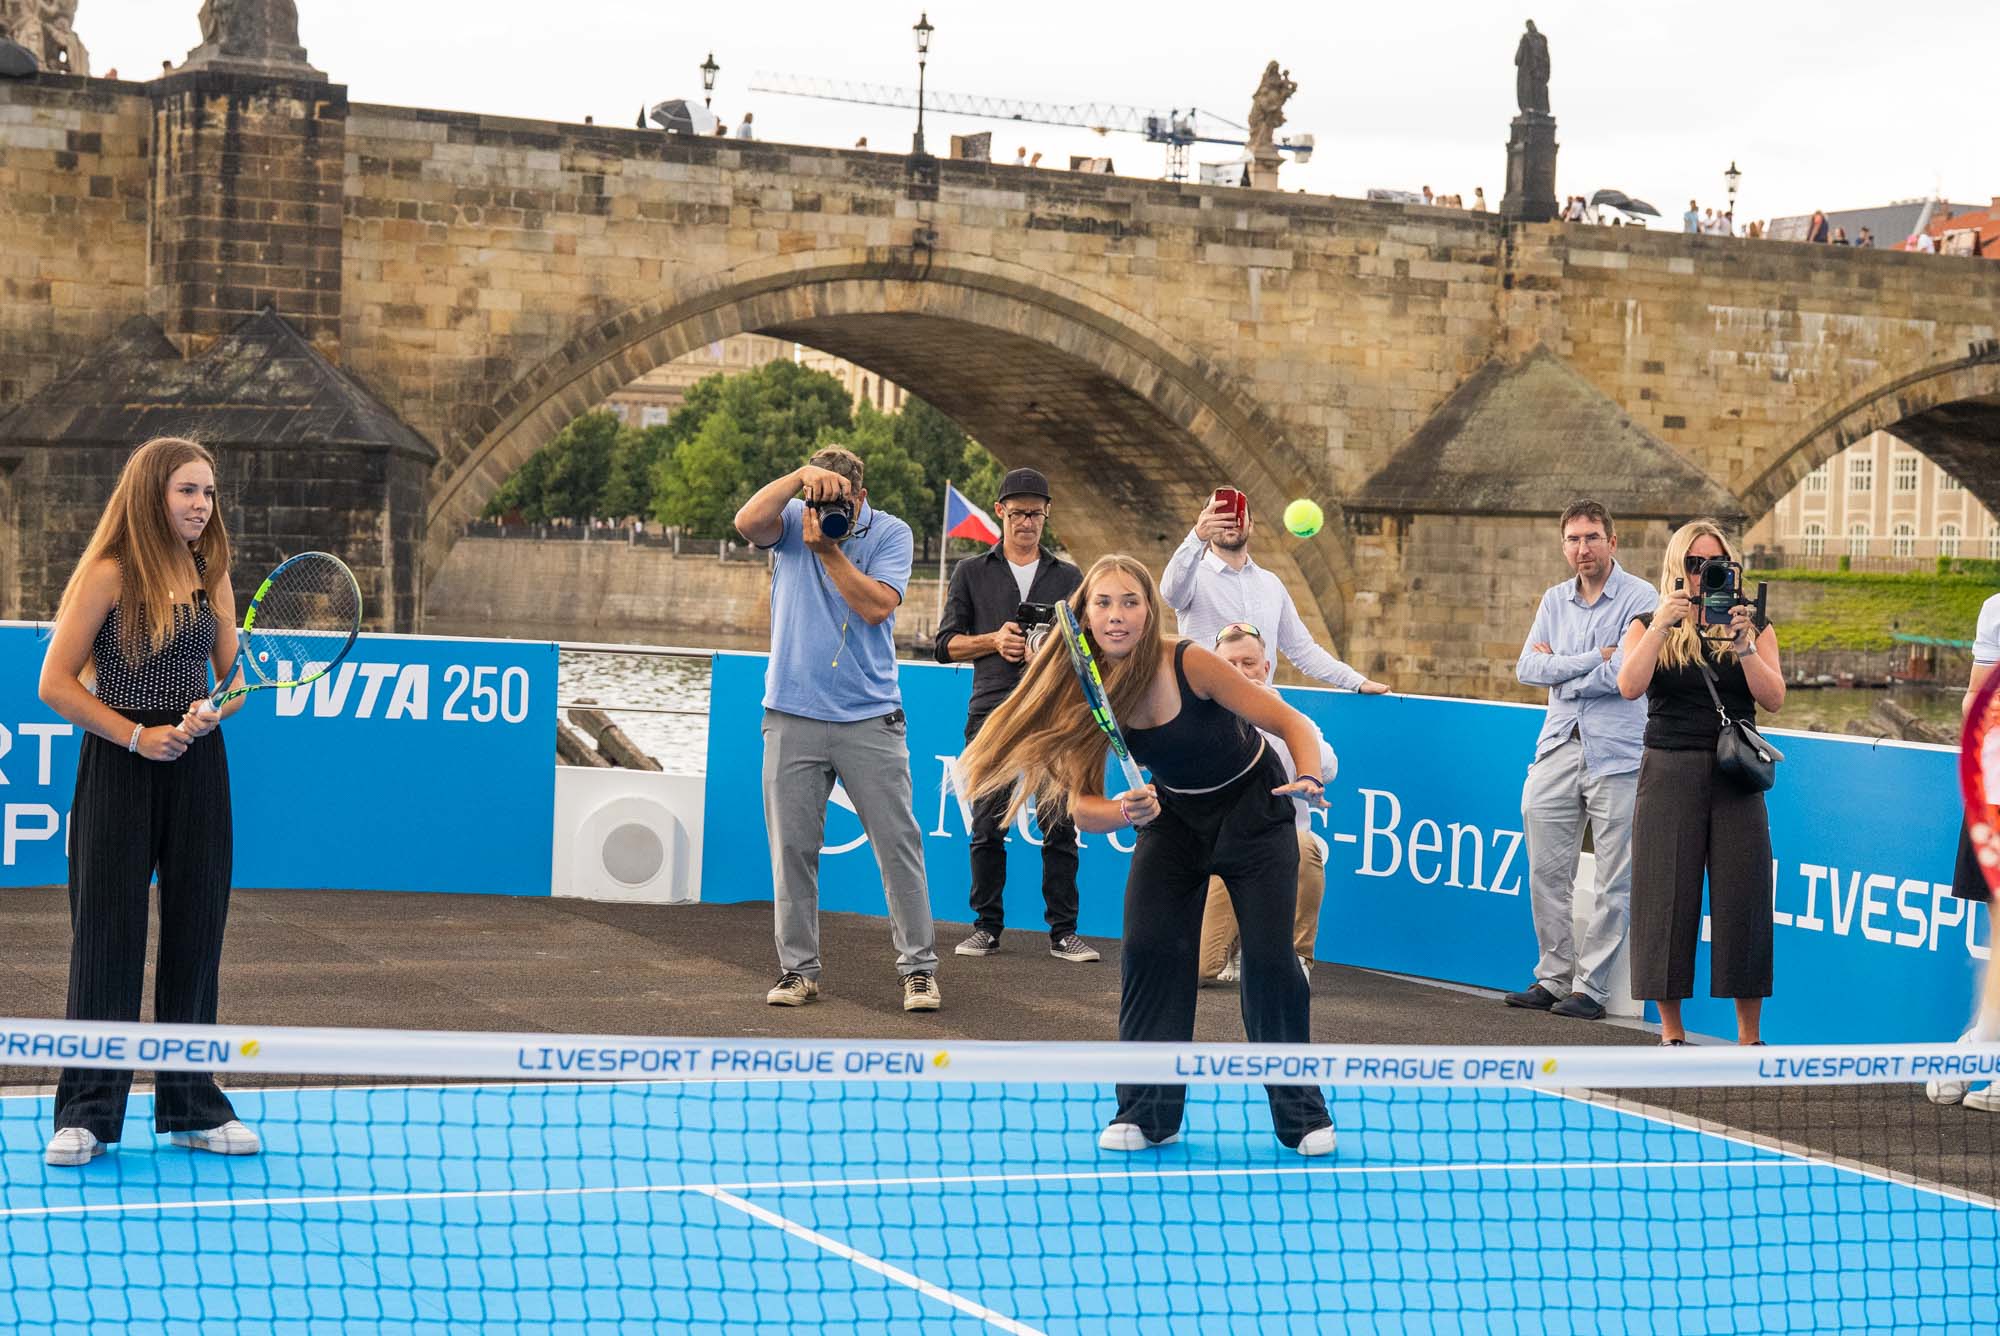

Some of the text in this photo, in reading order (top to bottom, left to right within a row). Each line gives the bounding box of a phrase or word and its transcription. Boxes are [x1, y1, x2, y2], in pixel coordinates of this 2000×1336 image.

[275, 660, 530, 724] WTA 250
[0, 722, 73, 785] T
[0, 1032, 230, 1063] RAGUE OPEN
[518, 1047, 925, 1074] LIVESPORT PRAGUE OPEN
[1176, 1055, 1535, 1081] LIVESPORT PRAGUE OPEN
[1758, 1056, 1904, 1079] LIVESPORT
